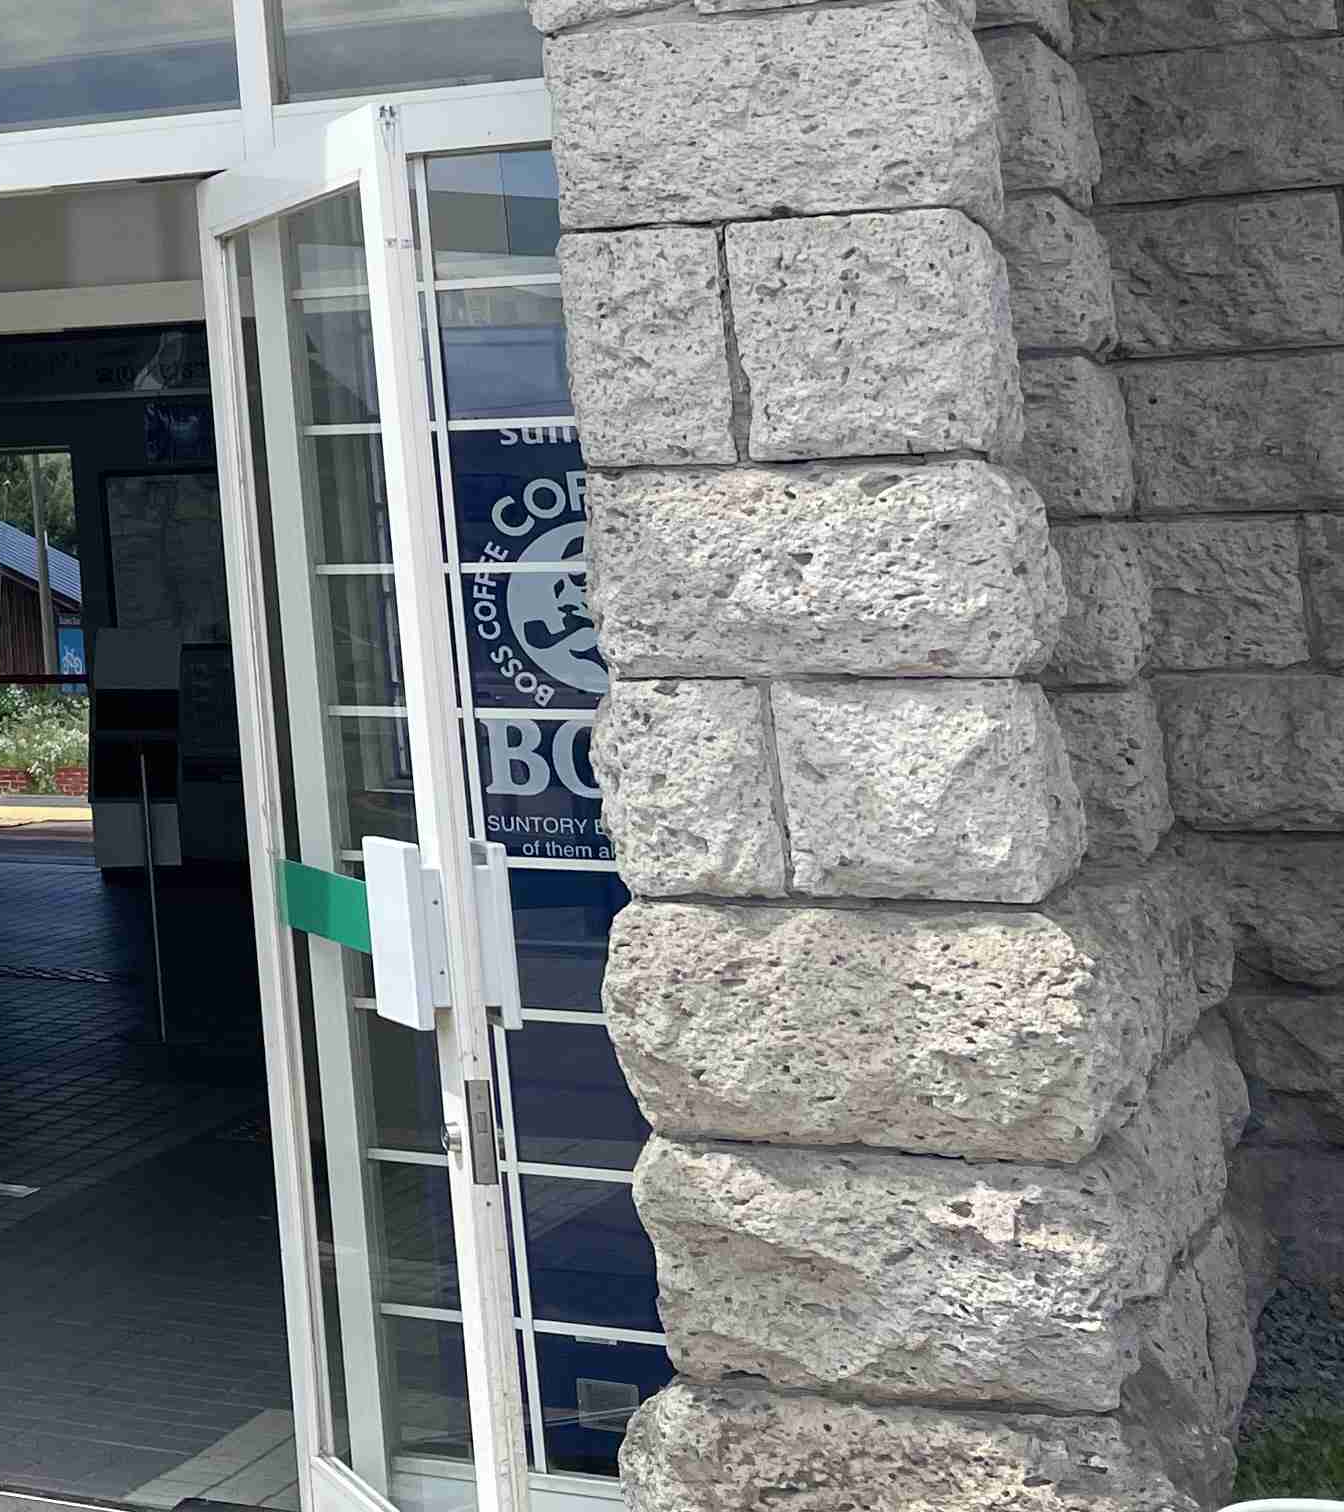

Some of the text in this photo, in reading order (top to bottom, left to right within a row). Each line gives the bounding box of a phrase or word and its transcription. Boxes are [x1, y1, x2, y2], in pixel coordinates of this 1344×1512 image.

[489, 644, 556, 708] BOSS
[487, 814, 588, 835] SUNTORY
[522, 841, 541, 857] of
[544, 841, 593, 859] them
